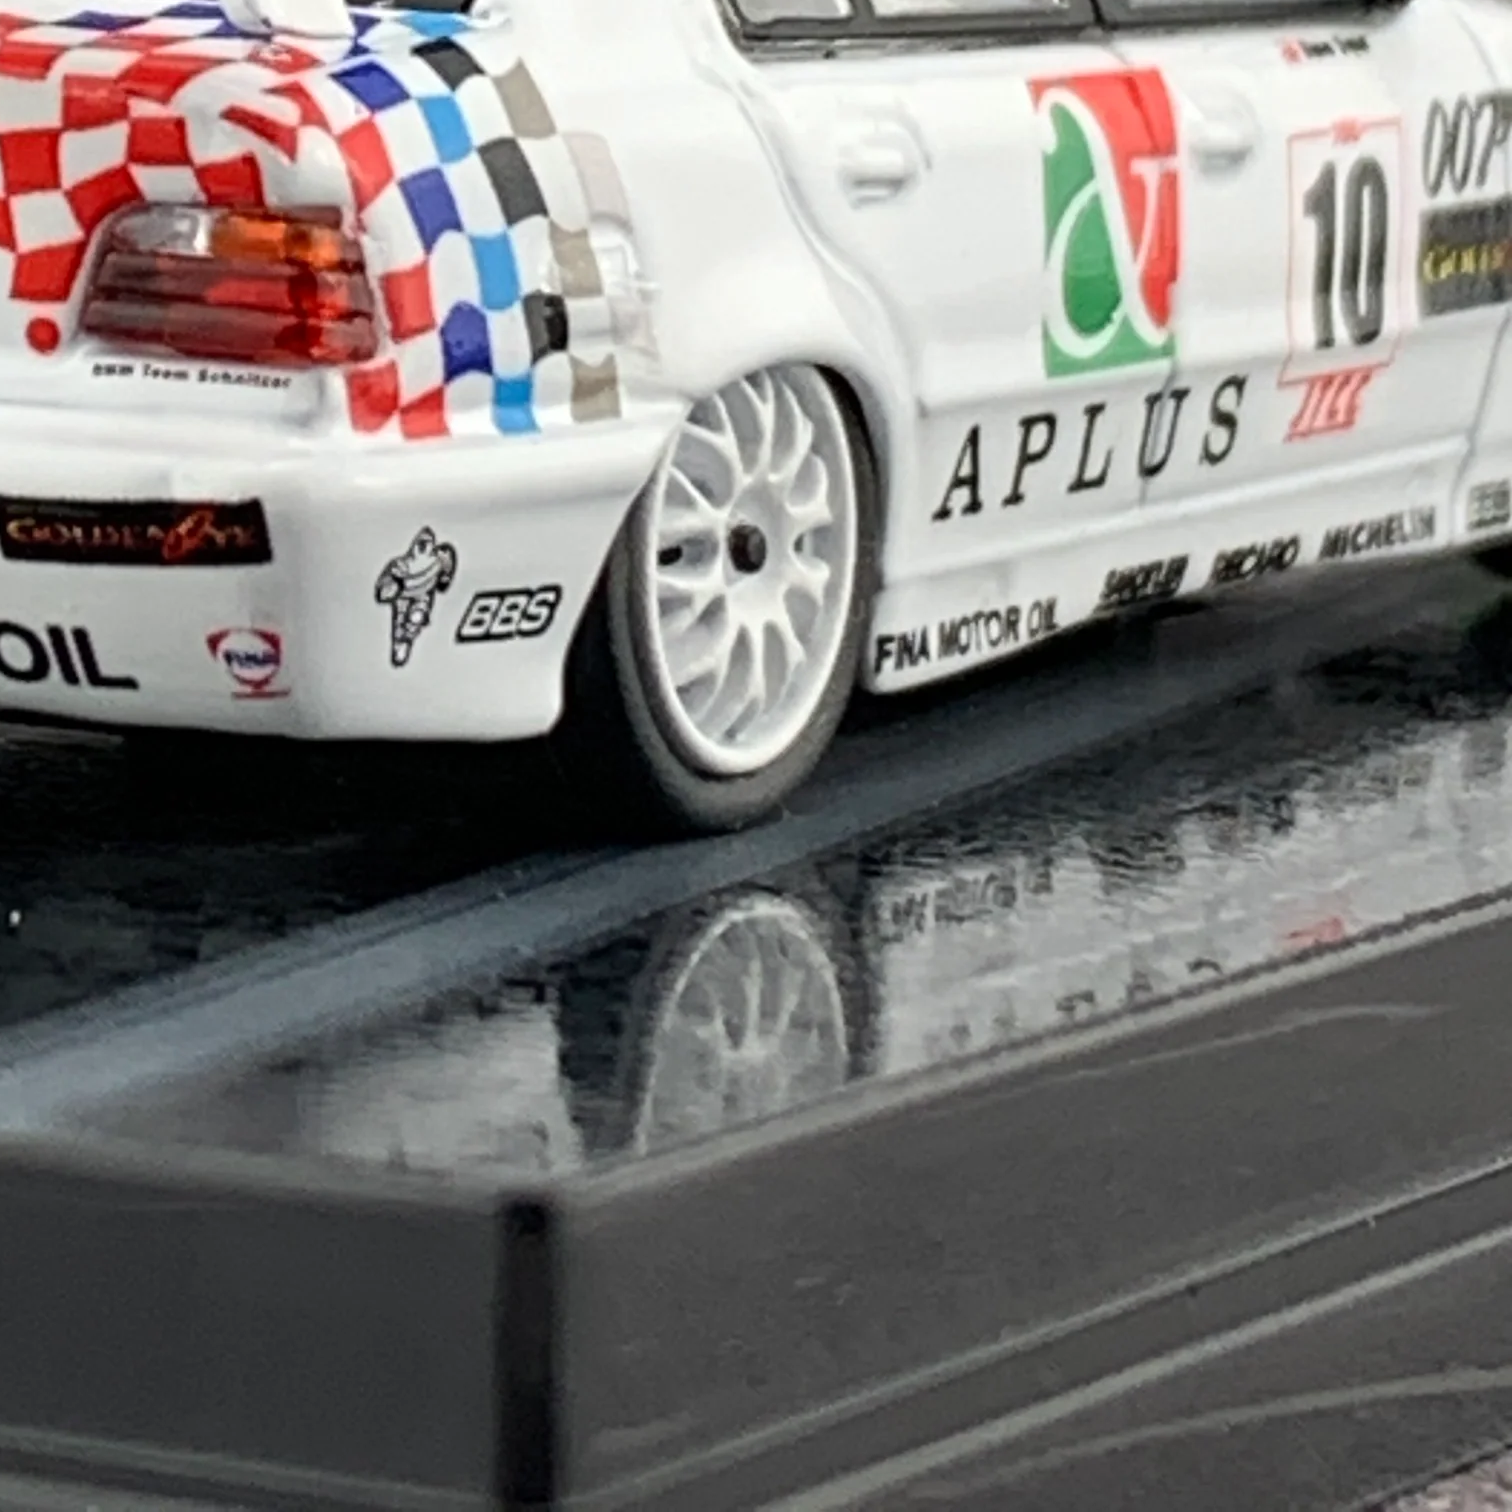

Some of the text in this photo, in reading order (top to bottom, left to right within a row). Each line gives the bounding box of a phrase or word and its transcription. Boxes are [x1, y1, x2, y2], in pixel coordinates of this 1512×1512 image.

[1302, 152, 1387, 351] 10
[931, 374, 1248, 522] APLUS
[1317, 506, 1436, 560] MICHELIN
[460, 589, 558, 638] BBS
[874, 596, 1061, 675] FINA MOTOR OIL
